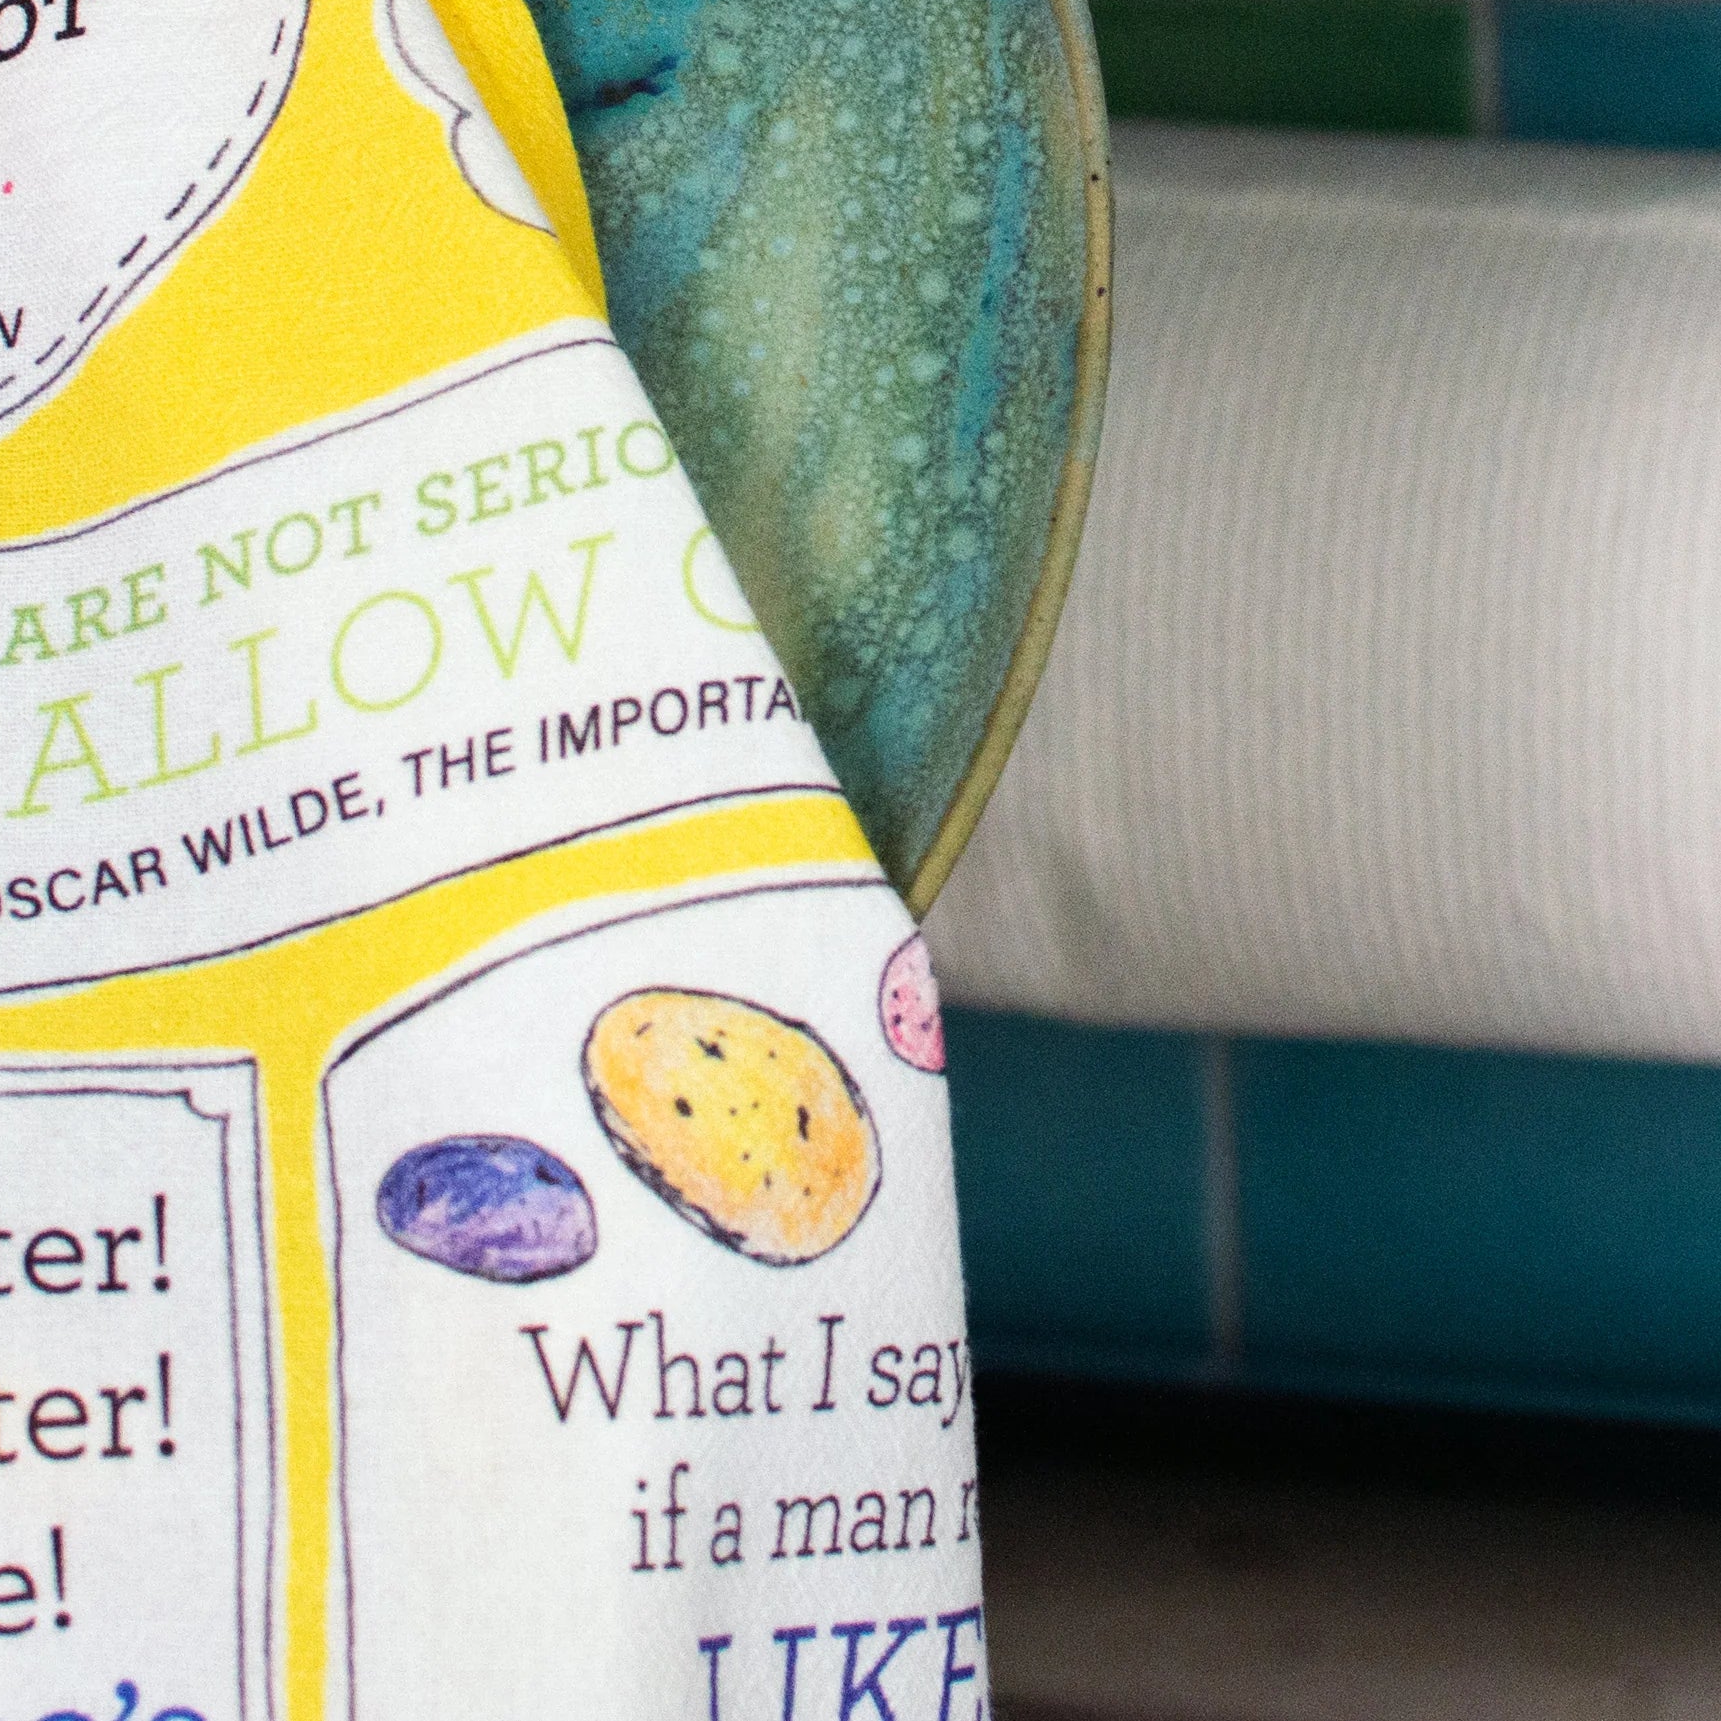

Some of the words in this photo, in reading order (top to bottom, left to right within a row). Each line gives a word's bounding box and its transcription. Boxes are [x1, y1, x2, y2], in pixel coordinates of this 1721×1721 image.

[196, 493, 382, 607] NOT
[182, 772, 387, 874] WILDE,
[403, 727, 515, 797] THE
[538, 675, 808, 763] IMPORTA
[519, 1310, 786, 1423] What
[811, 1315, 845, 1412] I
[867, 1340, 970, 1429] say
[631, 1461, 689, 1573] if
[710, 1499, 744, 1567] a
[770, 1486, 937, 1560] man
